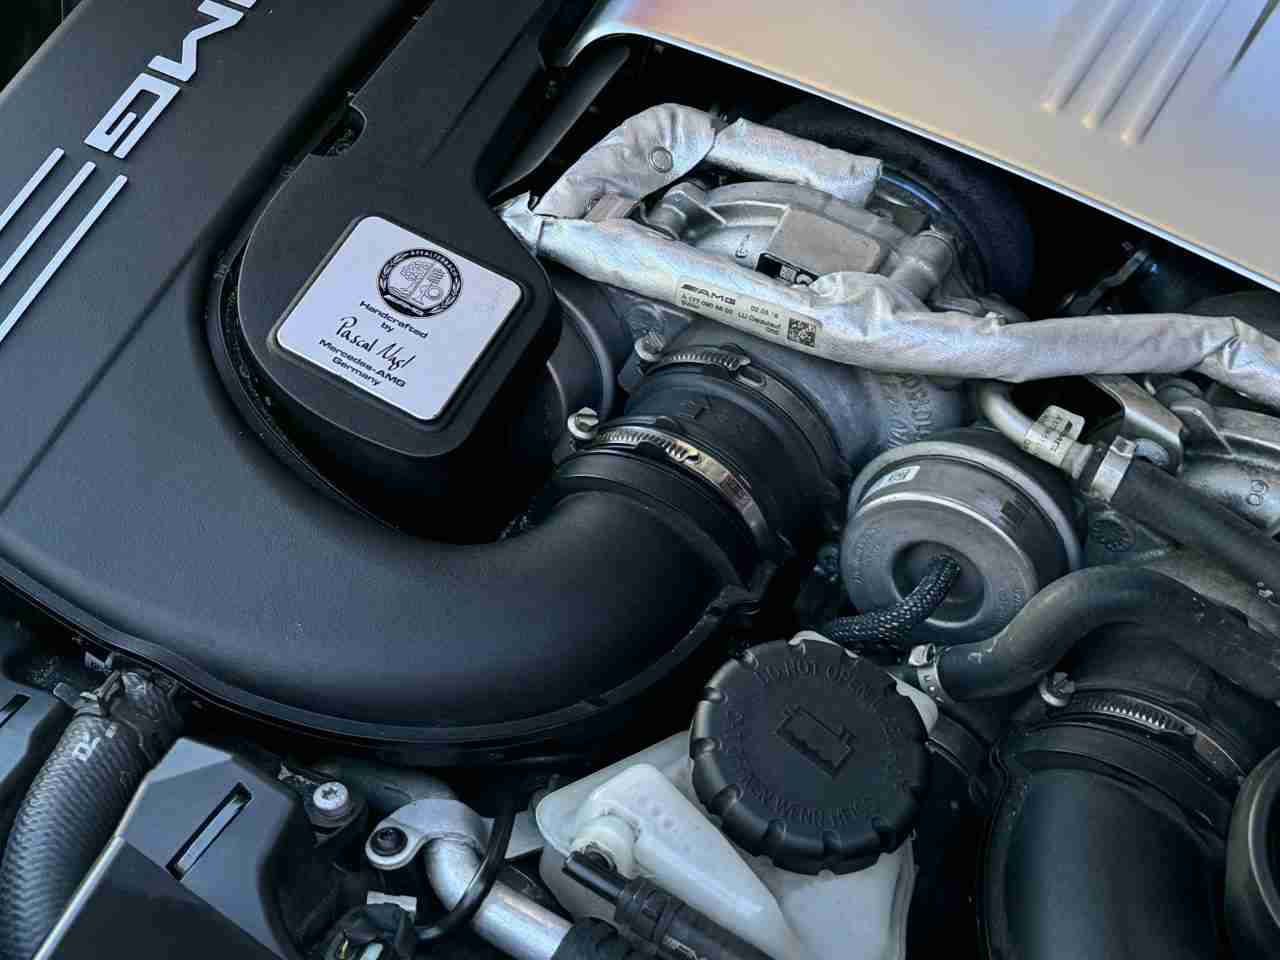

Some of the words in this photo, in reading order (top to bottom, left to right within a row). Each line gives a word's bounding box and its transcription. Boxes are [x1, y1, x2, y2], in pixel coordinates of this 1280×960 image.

[336, 316, 378, 352] Pascal
[359, 300, 429, 339] Handcrafted
[380, 322, 394, 333] by
[318, 338, 407, 388] Mercedes-AMG
[332, 355, 381, 386] Germany
